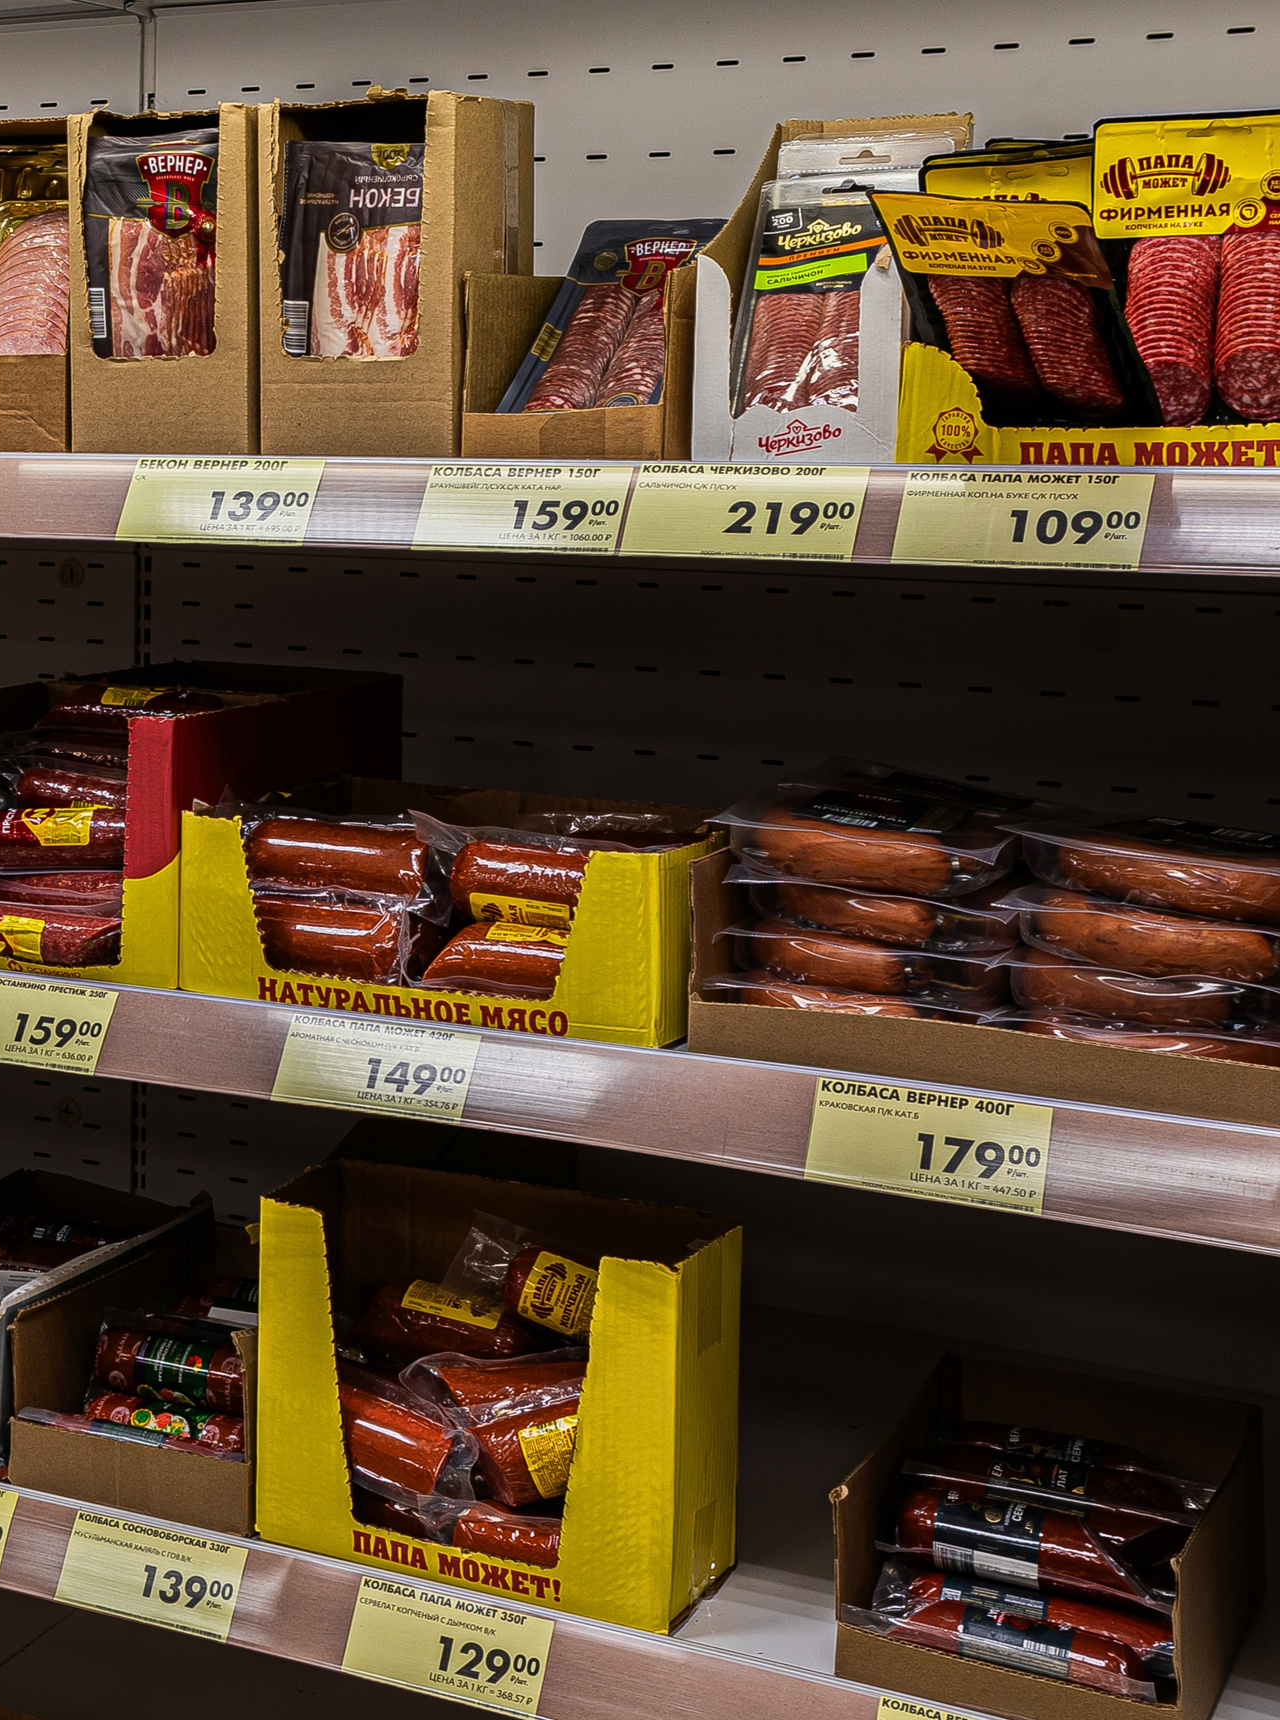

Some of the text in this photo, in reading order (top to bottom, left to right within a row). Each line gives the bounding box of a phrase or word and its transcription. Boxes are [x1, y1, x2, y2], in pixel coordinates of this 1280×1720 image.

[148, 155, 204, 174] ВЕРНЕР
[1138, 154, 1194, 170] ПАПА
[1142, 178, 1188, 189] МОЖЕТ
[350, 188, 421, 208] БЕКОН
[1100, 203, 1230, 222] ФИРМЕННАЯ
[772, 216, 794, 226] 200
[918, 216, 968, 230] ПАПА
[1125, 222, 1168, 230] КОПЧЕНАЯ
[778, 222, 862, 250] Черкизово
[929, 232, 970, 242] МОЖЕТ
[788, 247, 840, 261] ПРЕМИУМ
[902, 250, 1016, 265] ФИРМЕННАЯ
[767, 269, 824, 284] САЛЬЧИЧОН
[758, 424, 842, 452] Черкизово
[941, 425, 970, 437] 100%
[1020, 442, 1120, 466] ПАПА
[139, 460, 288, 472] БЕКОН ВЕРНЕР 200Г
[433, 467, 601, 478] КОЛБАСА ВЕРНЕР 150Г
[642, 465, 826, 476] КОЛБАСА ЧЕРКИЗОВО 200Г
[910, 472, 1120, 484] КОЛБАСА ПАПА МОЖЕТ 150Г
[906, 490, 966, 498] ФИРМЕННАЯ
[1006, 492, 1030, 500] БУКЕ
[26, 966, 82, 978] ОСТАНКИНО
[48, 985, 87, 997] ПРЕСТИЖ
[88, 990, 108, 999] 250Г
[258, 976, 568, 1037] НАТУРАЛЬНОЕ МЯСО
[294, 1014, 455, 1042] КОЛБАСА ПАПА МОЖЕТ 420Г
[821, 1080, 1014, 1116] КОЛБАСА ВЕРНЕР 400Г
[819, 1100, 920, 1120] КРАКОВСКАЯ КАТ.Б
[910, 1172, 942, 1186] ЦЕНА
[944, 1176, 958, 1187] ЗА
[992, 1184, 1026, 1198] 447.50
[74, 1530, 132, 1549] МУСУЛЬМАНСКАЯ
[78, 1512, 231, 1554] КОЛБАСА СОСНОВОБОРСКАЯ 330Г
[352, 1529, 562, 1603] ПАПА МОЖЕТ!
[363, 1578, 528, 1626] КОЛБАСА ПАПА МОЖЕТ 350Г
[359, 1596, 484, 1634] СЕРВЕЛАТ КОПЧЕНЫЙ ДЫМКОМ
[429, 1672, 456, 1687] ЦЕНА
[882, 1698, 942, 1720] КОЛБАСА
